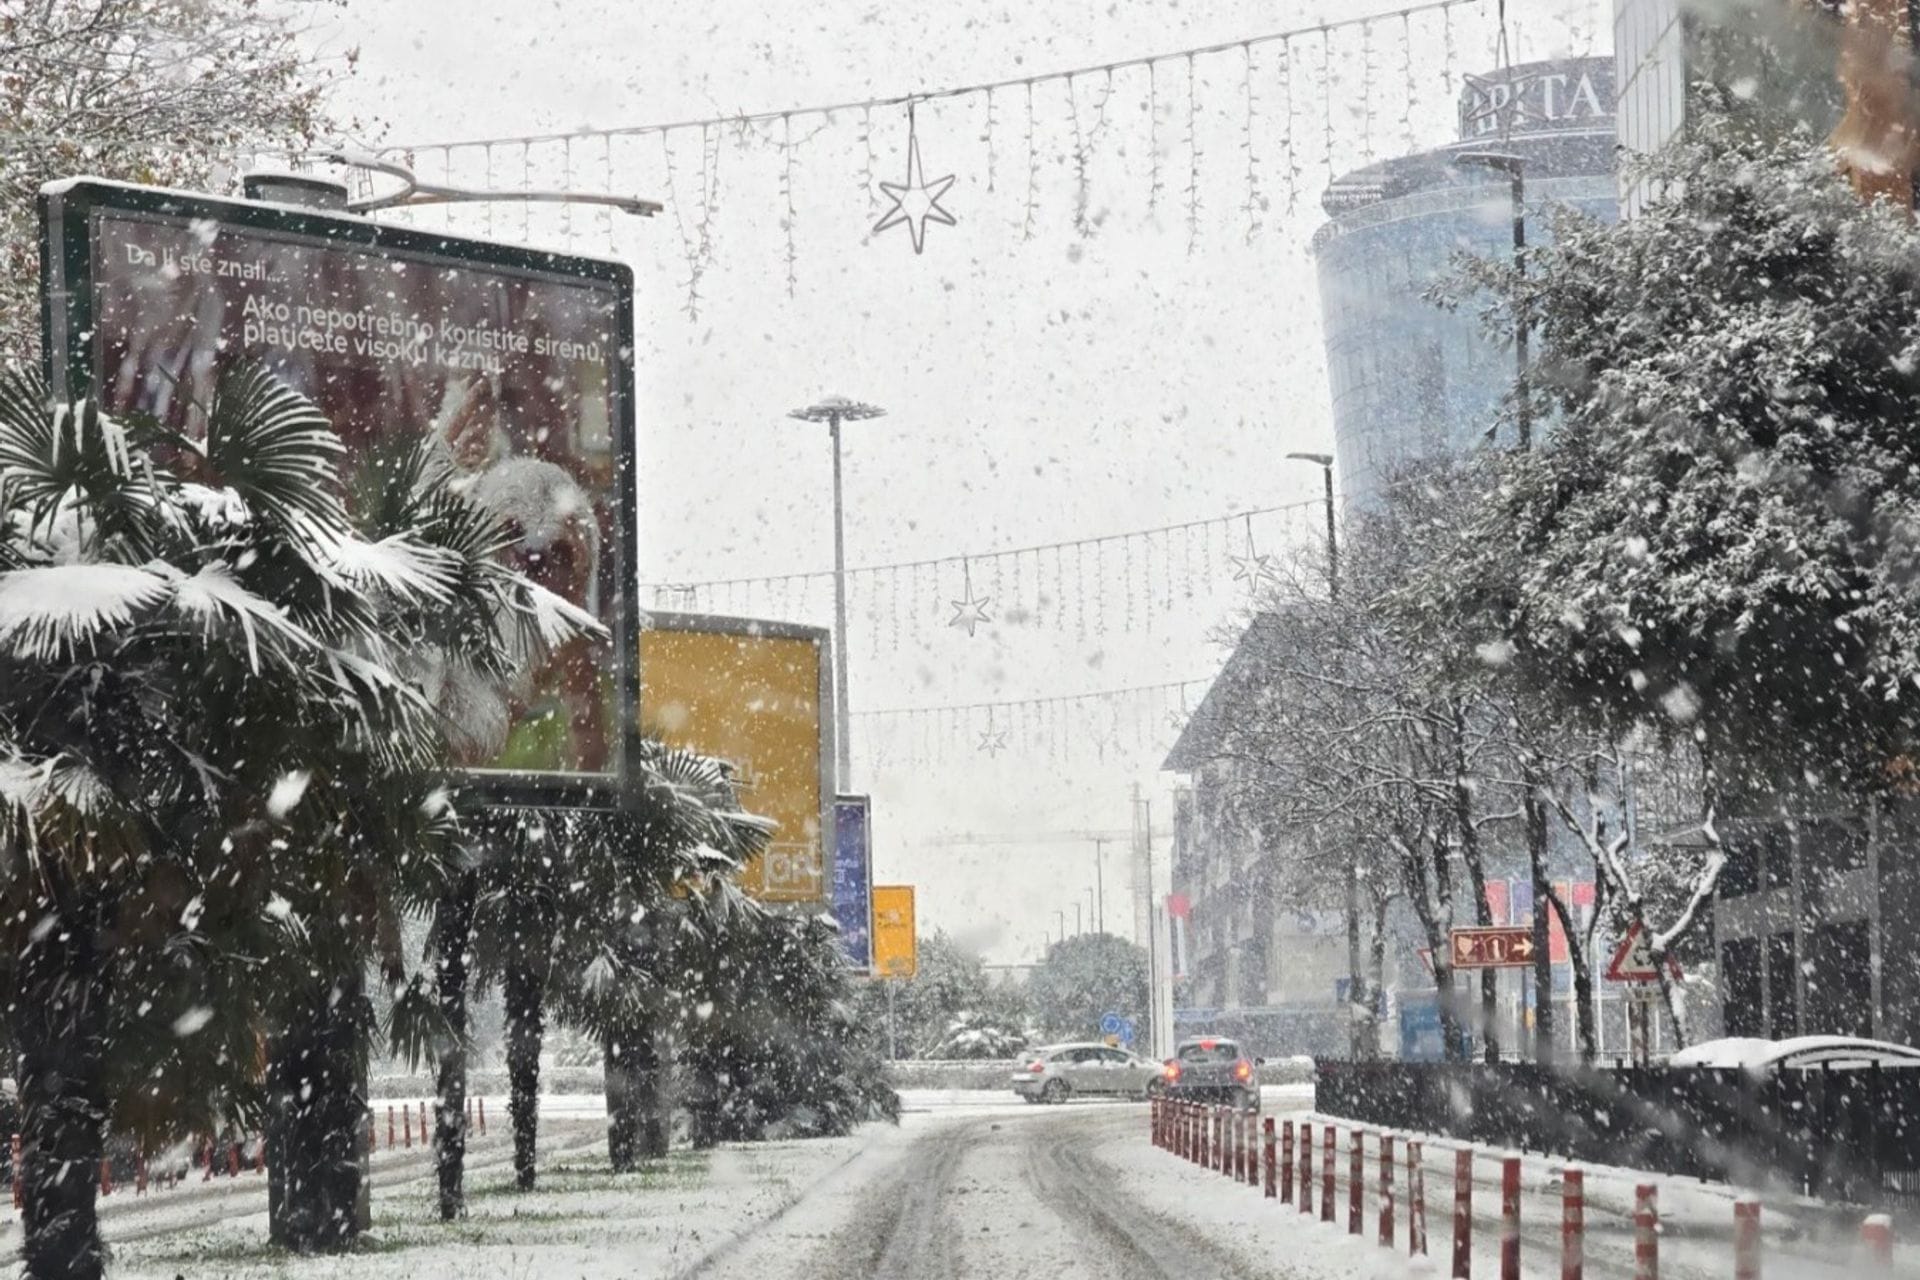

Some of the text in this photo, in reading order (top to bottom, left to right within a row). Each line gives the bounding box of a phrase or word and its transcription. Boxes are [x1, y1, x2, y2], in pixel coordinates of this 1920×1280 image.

[125, 243, 156, 266] Da
[180, 252, 212, 273] ste
[242, 294, 599, 362] Ako nepotrebno koristite sirenu
[353, 333, 428, 362] visoku
